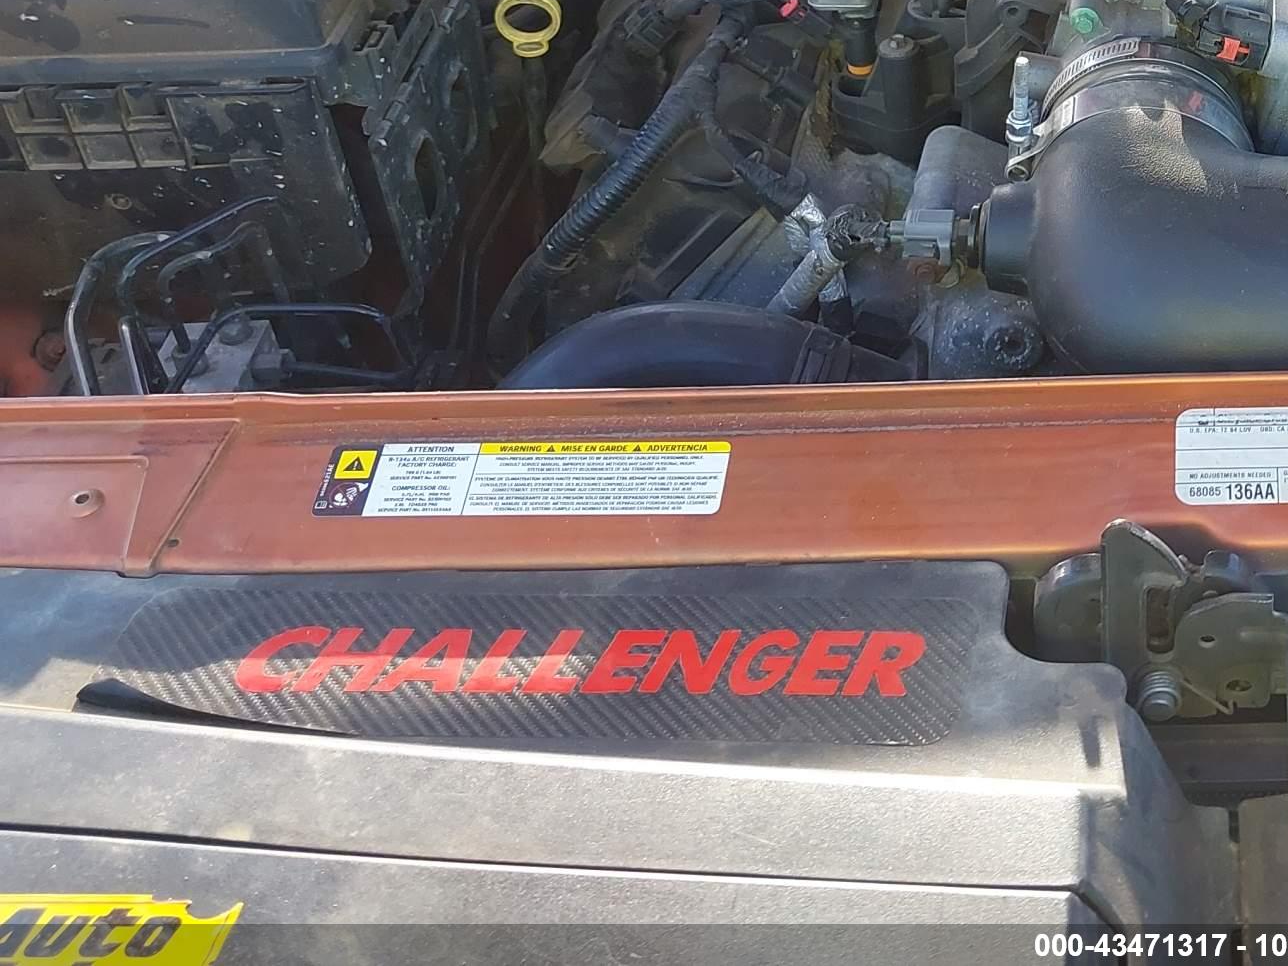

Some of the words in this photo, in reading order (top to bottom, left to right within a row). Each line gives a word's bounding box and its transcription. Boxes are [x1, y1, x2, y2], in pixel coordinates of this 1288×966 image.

[598, 444, 628, 452] GARDE
[646, 444, 708, 452] ADVERTENCIA
[1189, 486, 1221, 497] 68085
[1225, 483, 1275, 500] 136AA
[234, 624, 928, 699] CHALLENGER
